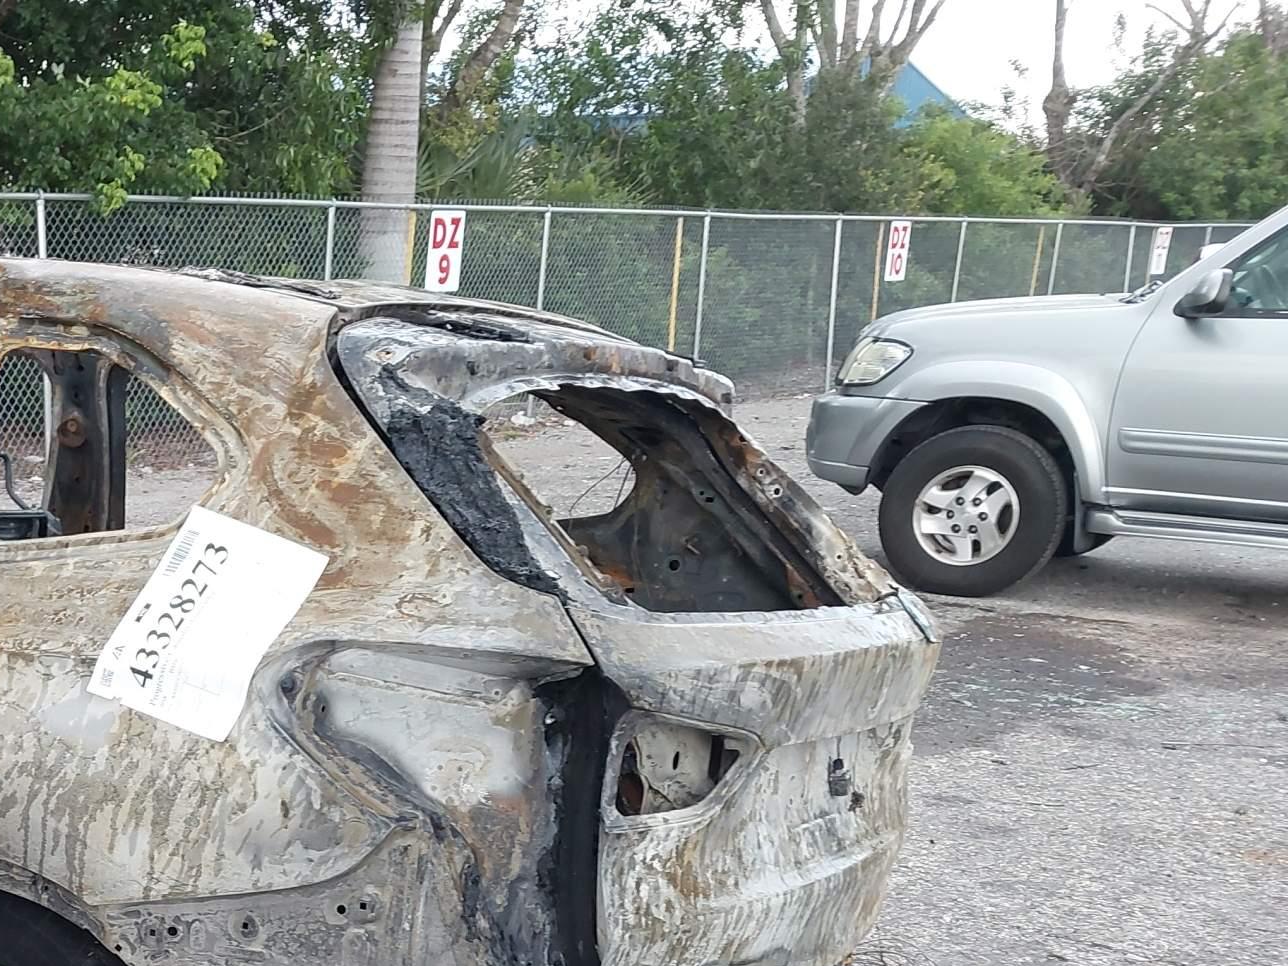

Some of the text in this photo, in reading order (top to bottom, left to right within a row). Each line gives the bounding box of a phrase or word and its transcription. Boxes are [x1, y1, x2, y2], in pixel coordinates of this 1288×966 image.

[432, 217, 462, 249] DZ
[891, 226, 909, 249] DZ
[438, 253, 450, 285] 9
[889, 253, 903, 275] 10
[129, 542, 229, 689] 43328273
